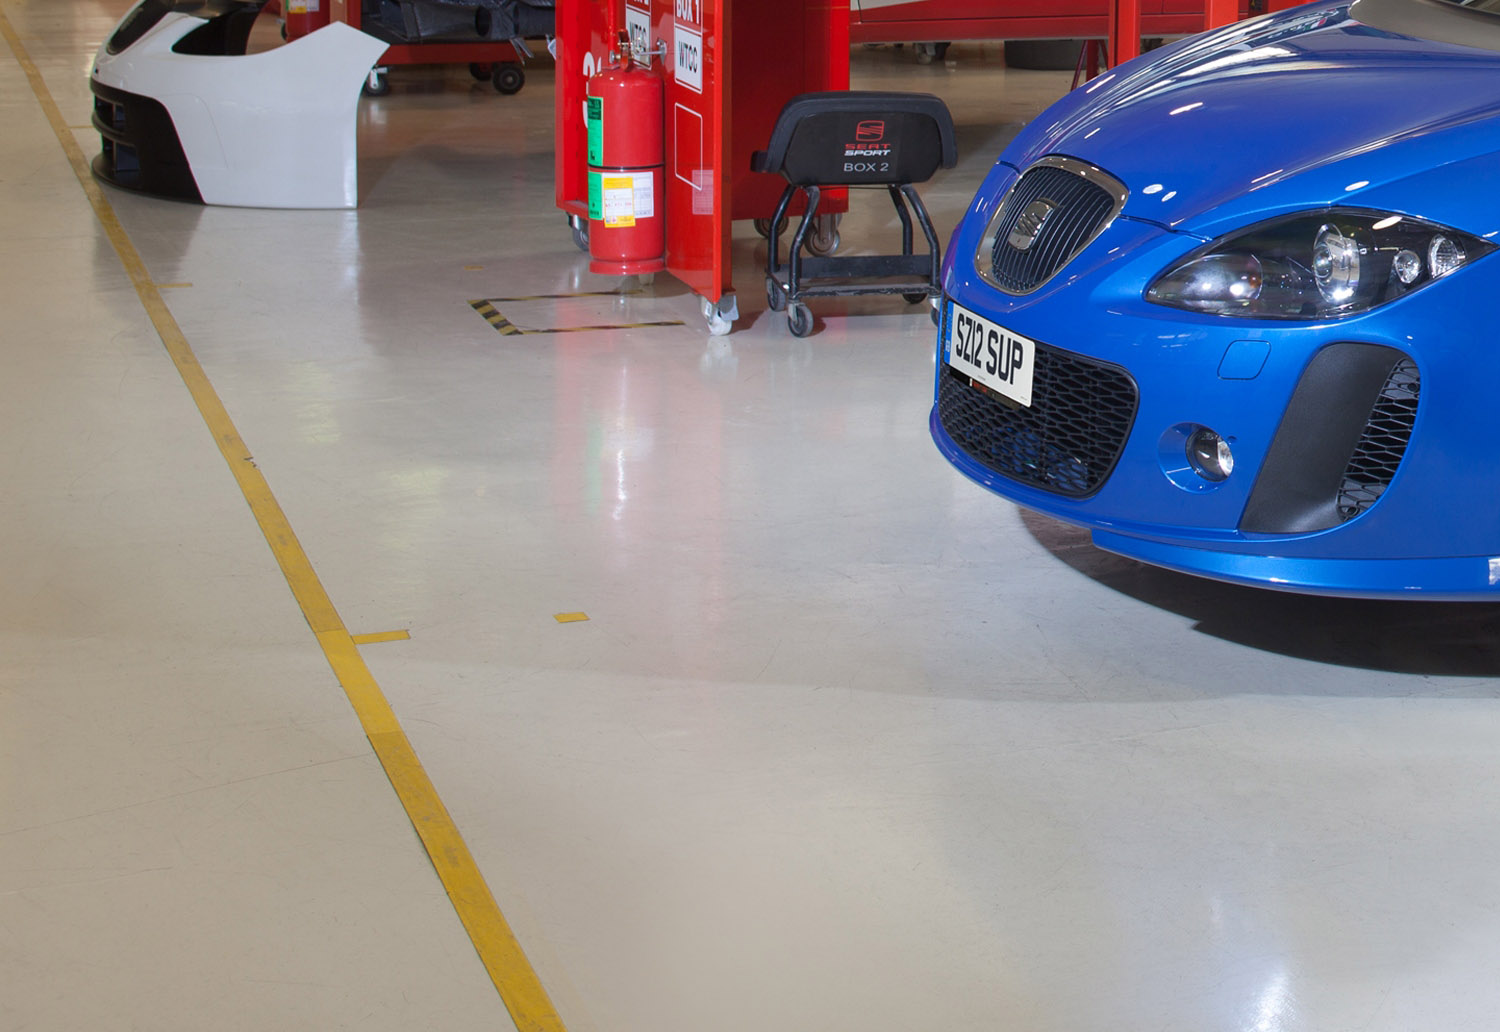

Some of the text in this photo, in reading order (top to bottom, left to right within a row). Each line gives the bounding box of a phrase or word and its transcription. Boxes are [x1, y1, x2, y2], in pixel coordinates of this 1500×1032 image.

[678, 41, 698, 74] WTCC
[844, 149, 892, 157] SPORT
[843, 162, 889, 172] BOX 2
[955, 312, 1024, 385] SZ12 SUP
